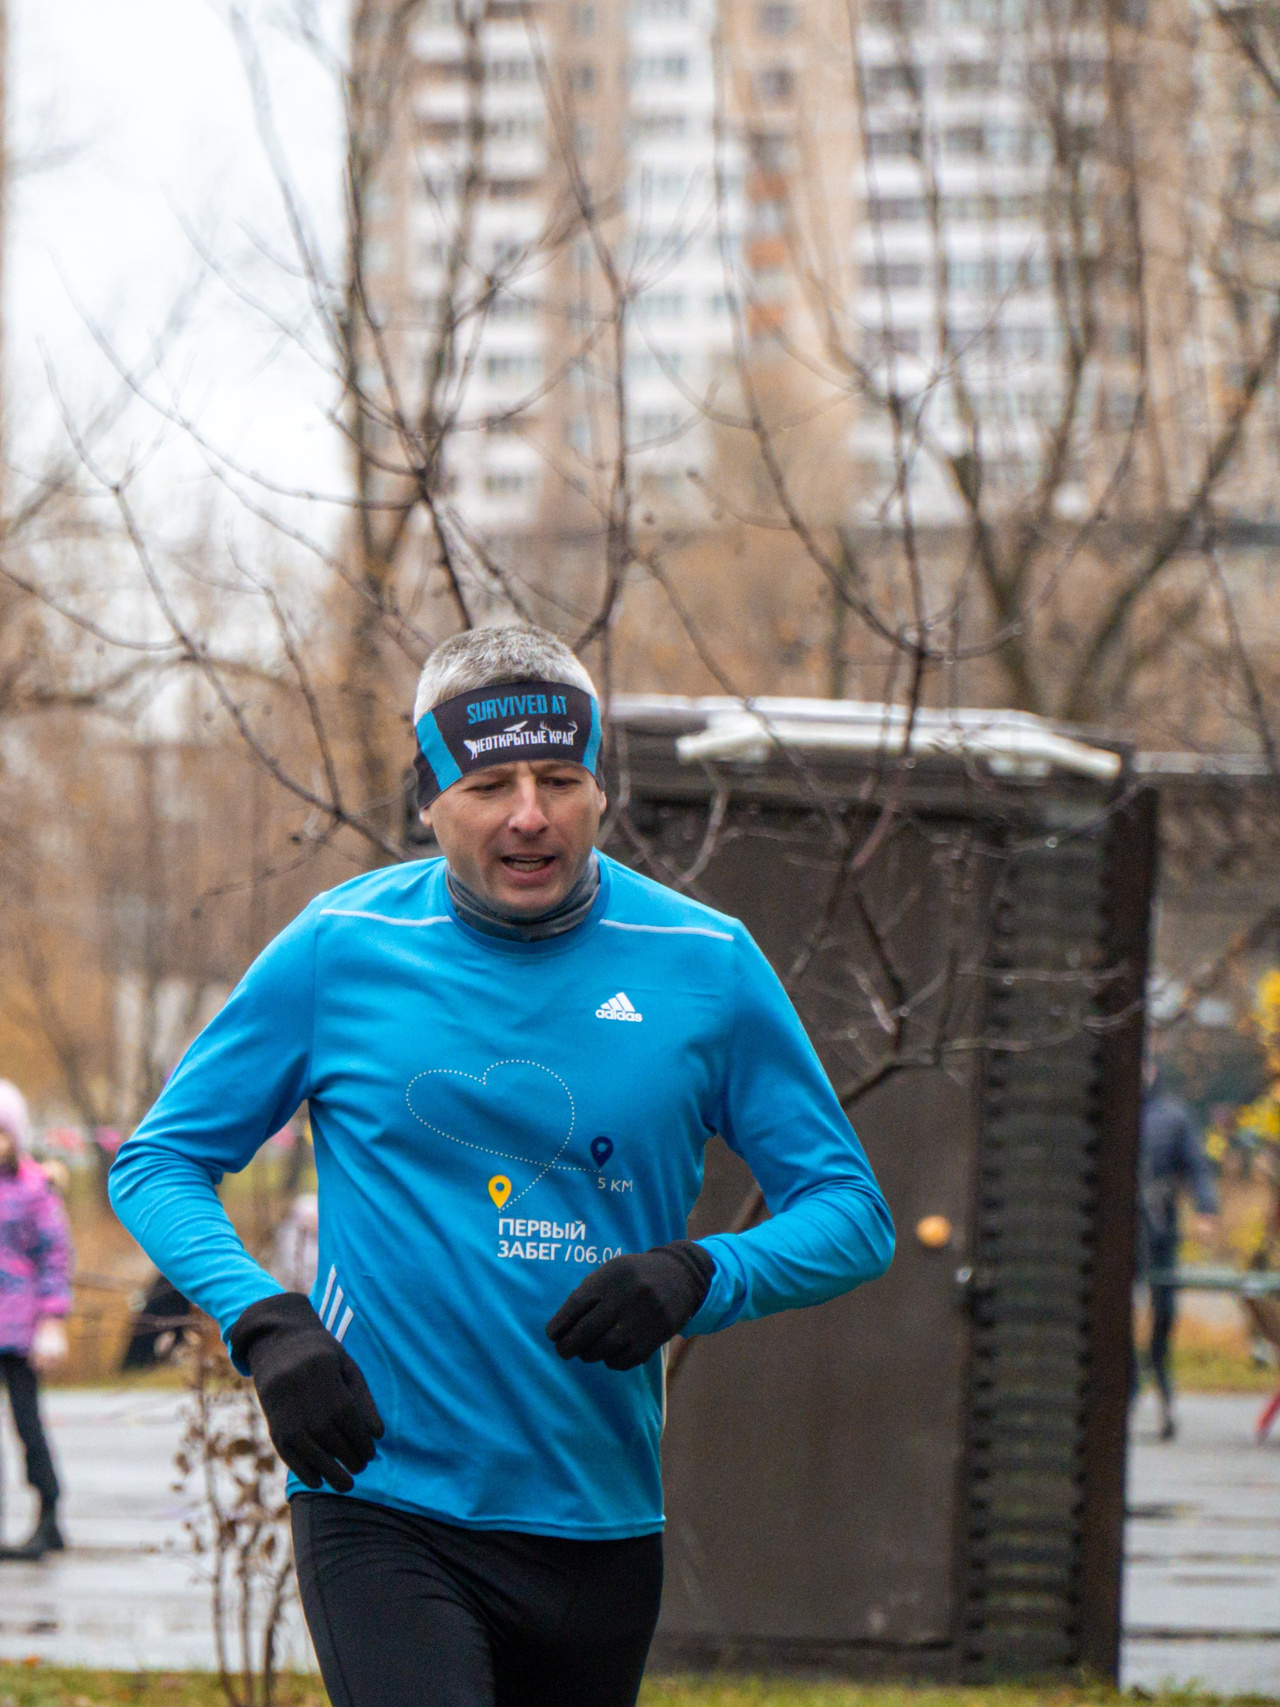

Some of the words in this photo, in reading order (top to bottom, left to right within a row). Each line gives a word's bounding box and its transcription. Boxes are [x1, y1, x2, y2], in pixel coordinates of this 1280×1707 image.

[466, 694, 548, 725] SURVIVED
[552, 695, 568, 715] AT
[474, 730, 548, 753] НЕОТКРЫТЫЕ
[595, 1009, 643, 1023] adidas
[597, 1177, 606, 1190] 5
[498, 1218, 586, 1241] ПЕРВЫЙ
[497, 1240, 562, 1261] ЗАБЕГ
